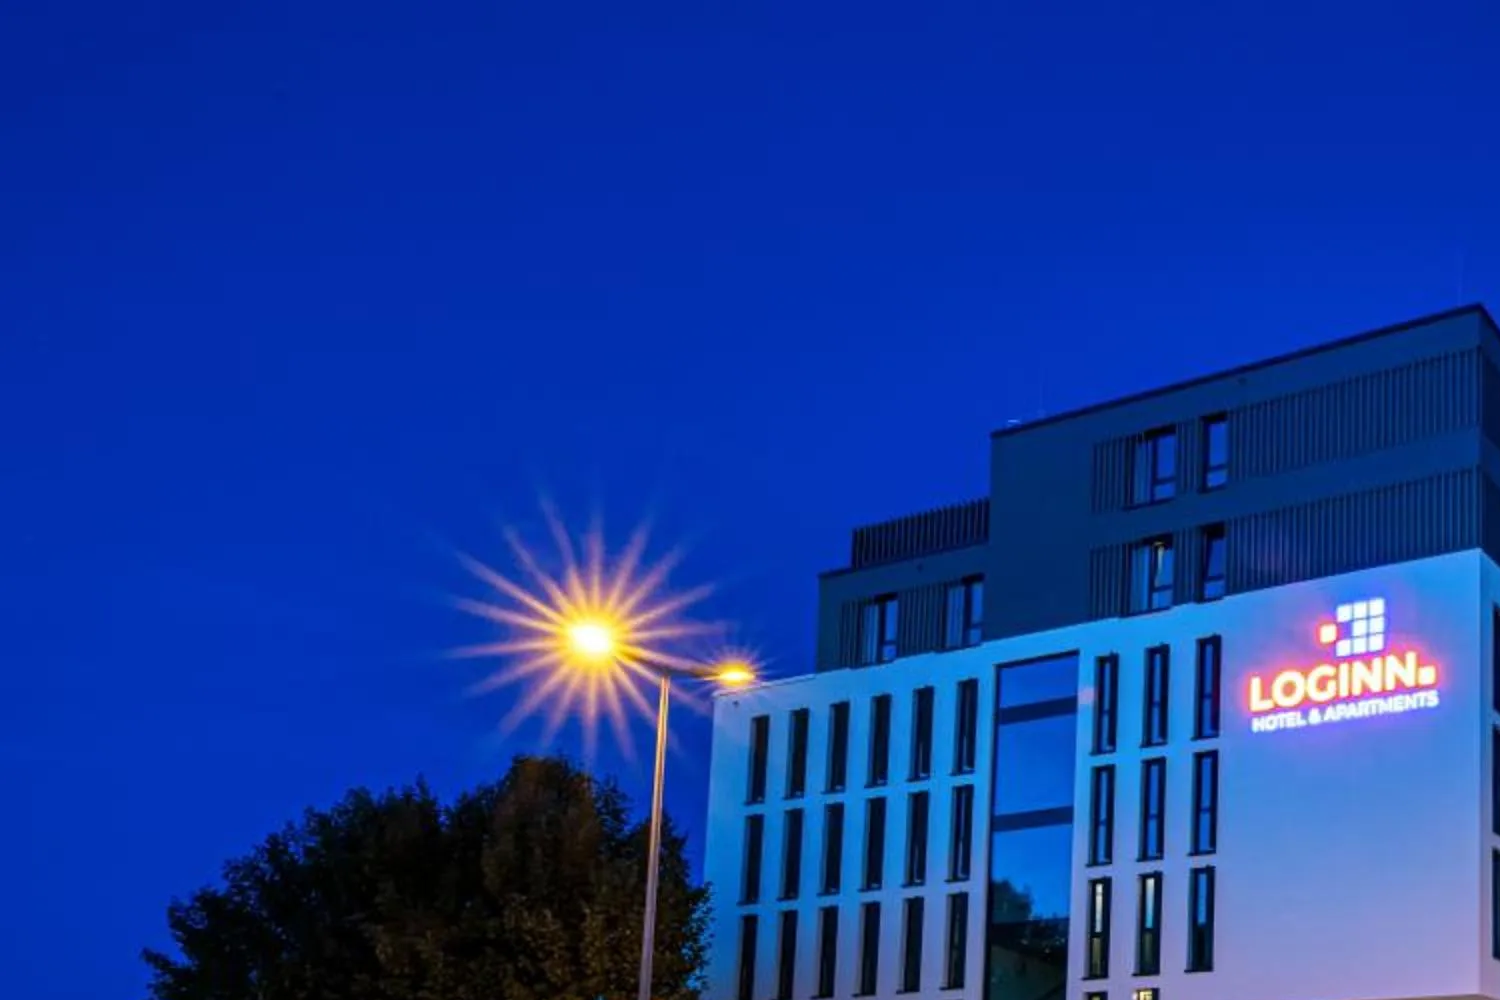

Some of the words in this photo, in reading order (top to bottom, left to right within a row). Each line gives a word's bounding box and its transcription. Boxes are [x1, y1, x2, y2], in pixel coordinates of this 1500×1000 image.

[1251, 711, 1306, 733] HOTEL
[1308, 709, 1321, 724] &
[1323, 690, 1439, 722] APARTMENTS
